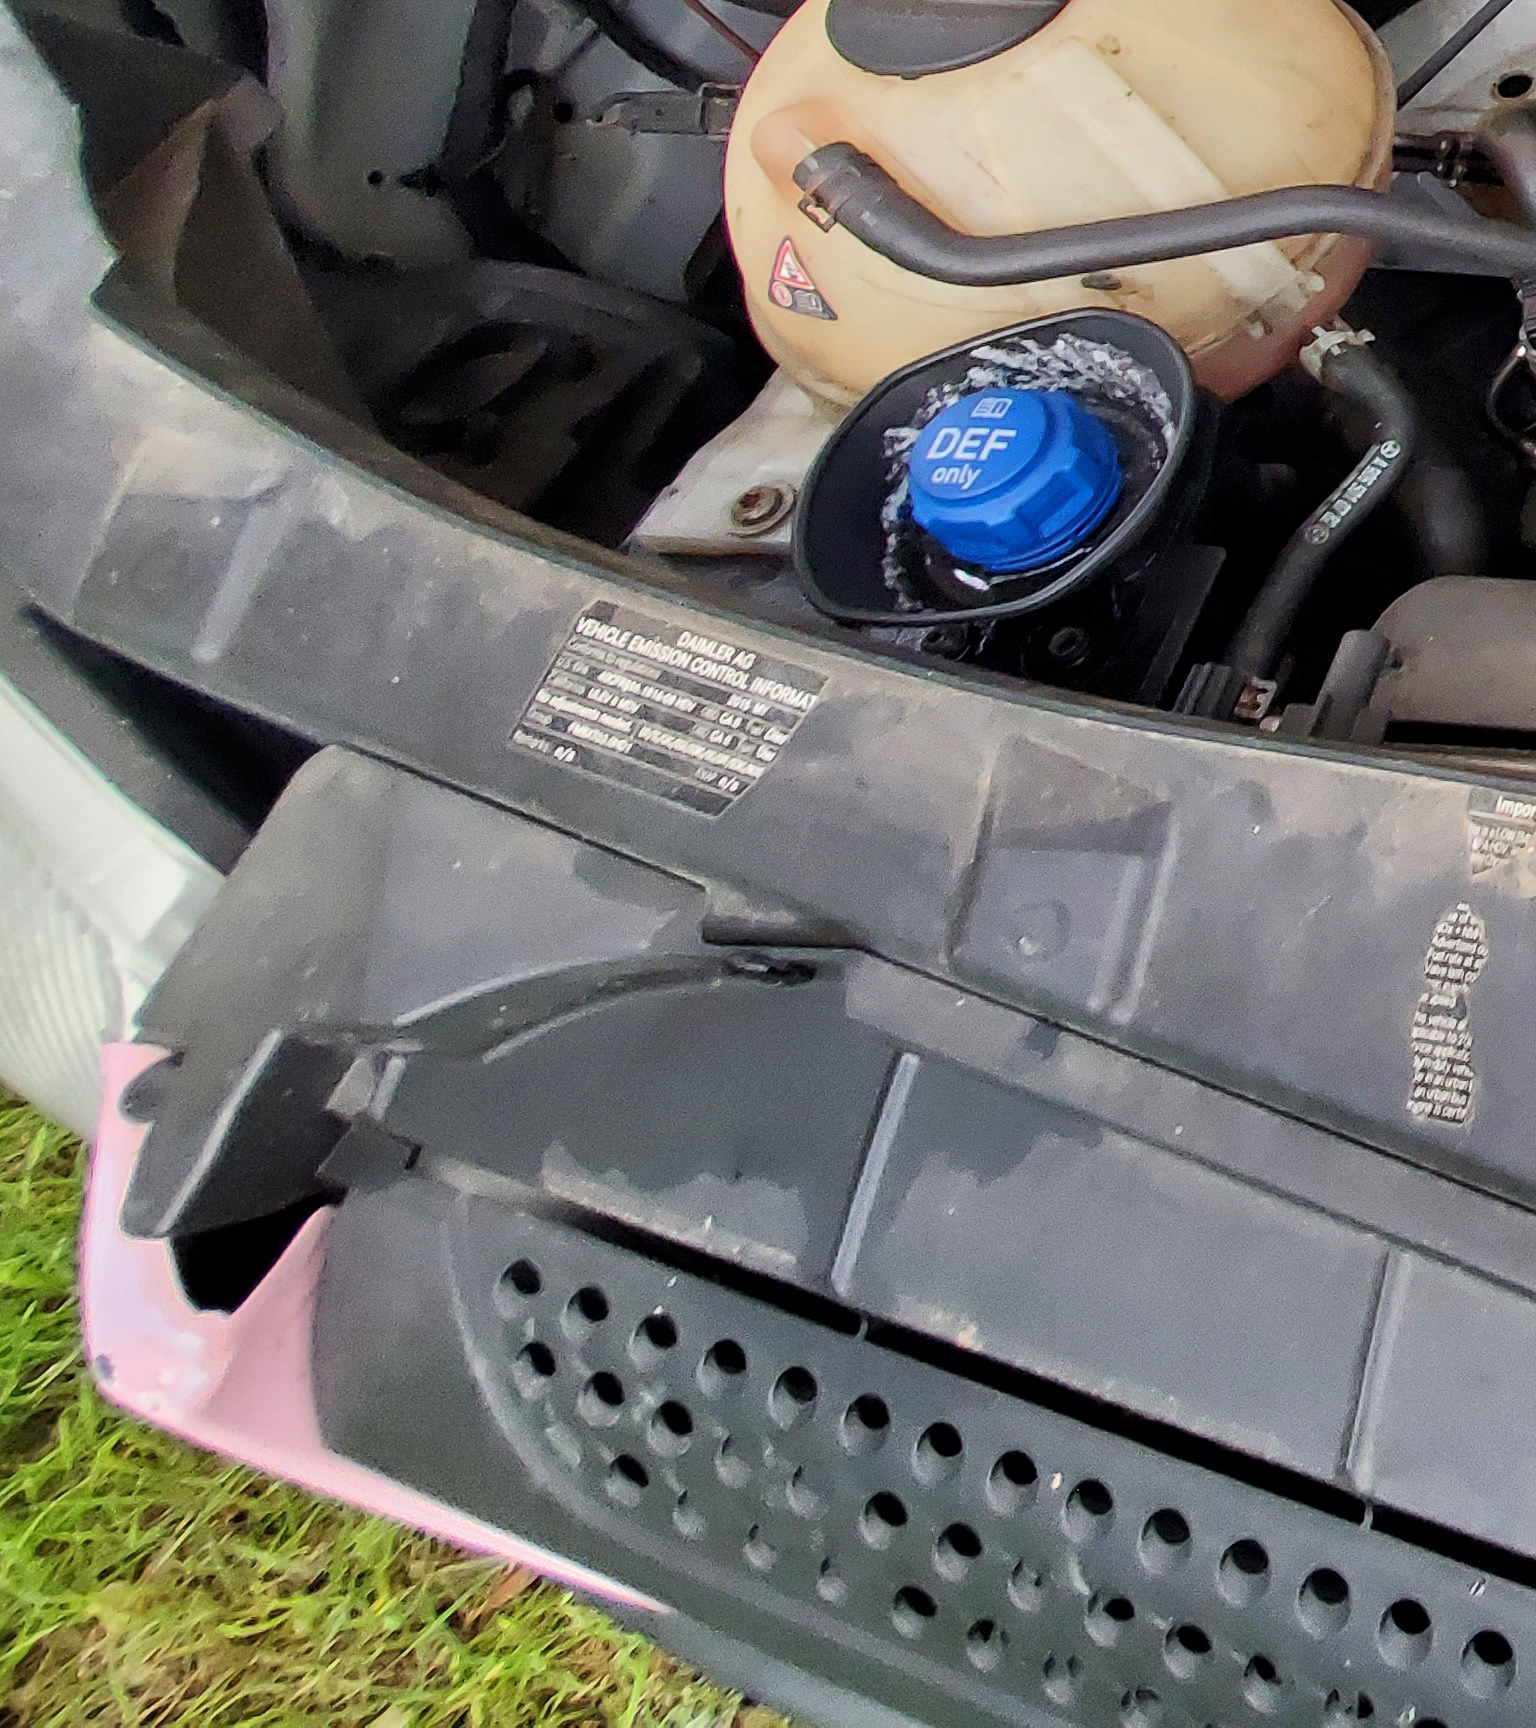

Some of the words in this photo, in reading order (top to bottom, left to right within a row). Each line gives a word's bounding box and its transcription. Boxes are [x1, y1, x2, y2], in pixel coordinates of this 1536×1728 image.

[926, 427, 1017, 460] DEF
[931, 464, 982, 490] only
[575, 616, 632, 649] VEHICLE
[626, 635, 693, 669] EMISSION
[690, 657, 751, 690] CONTROL
[677, 631, 735, 663] DAIMLER
[731, 651, 756, 670] AG
